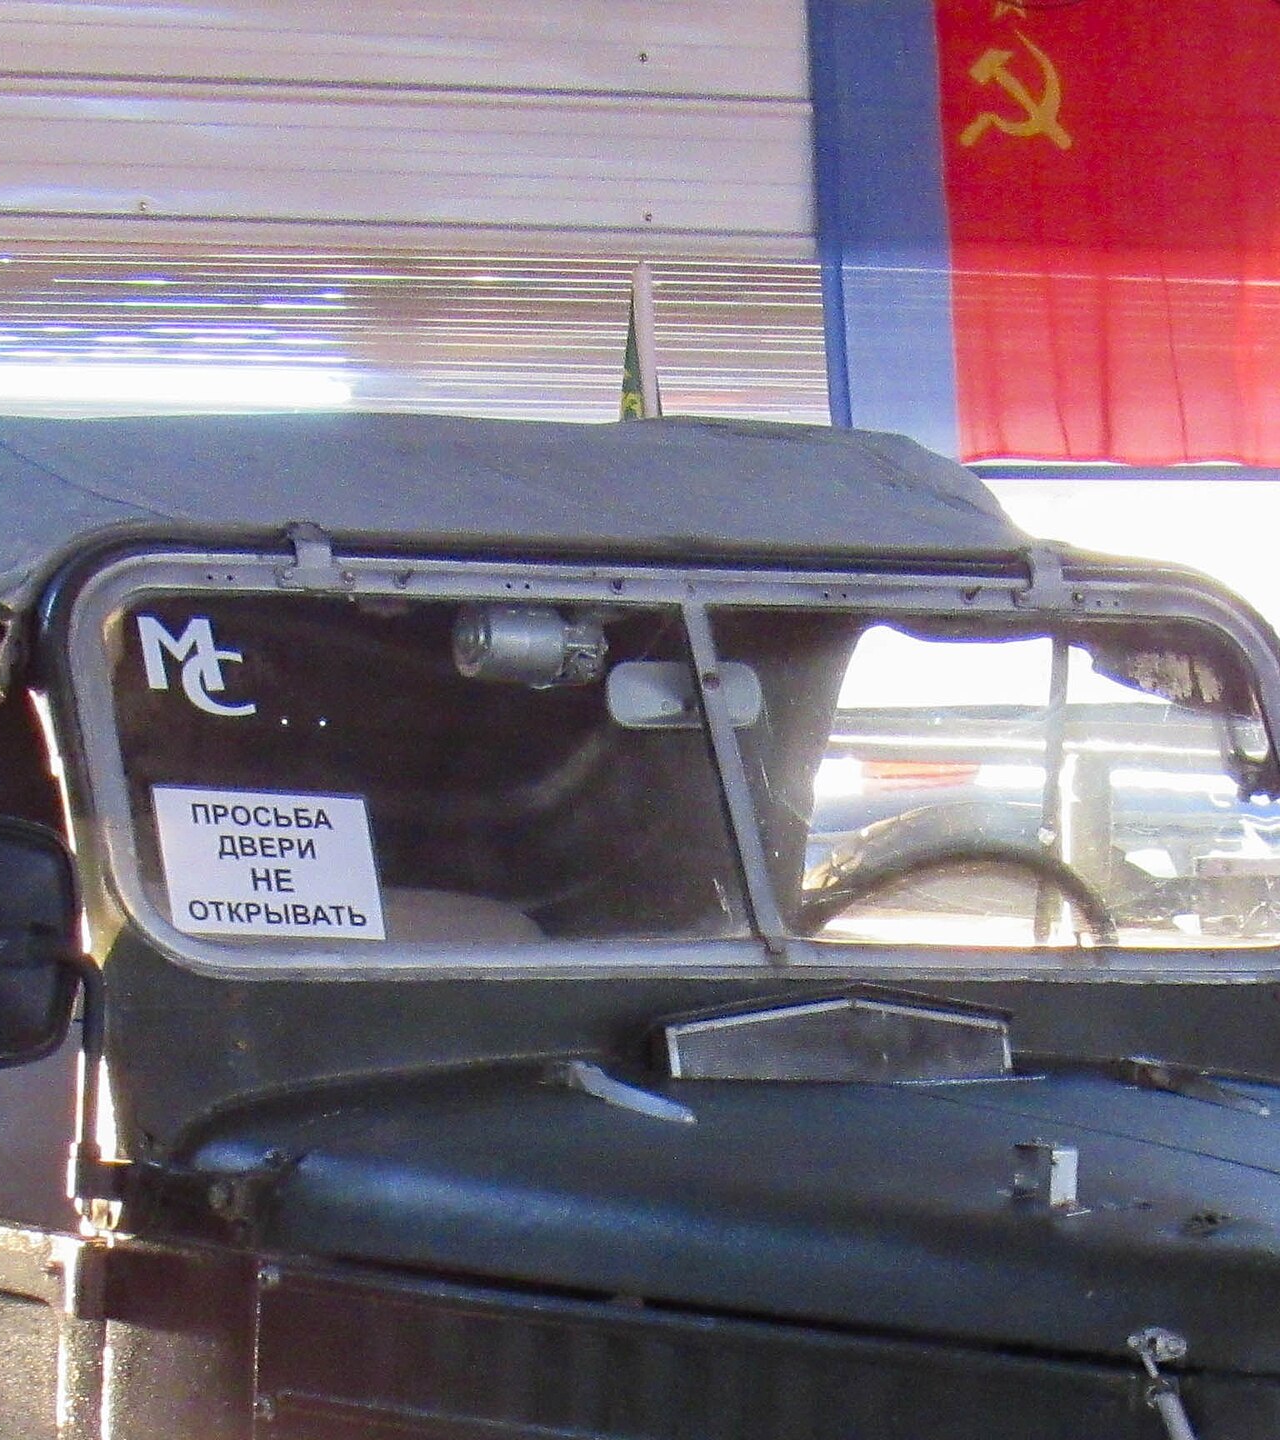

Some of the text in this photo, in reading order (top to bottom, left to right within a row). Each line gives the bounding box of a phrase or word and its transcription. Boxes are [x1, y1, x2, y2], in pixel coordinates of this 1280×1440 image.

[191, 802, 334, 831] ПРОСЬБА
[218, 835, 317, 861] ДВЕРИ
[251, 867, 296, 894] НЕ
[188, 899, 369, 928] ОТКРЫВАТЬ
